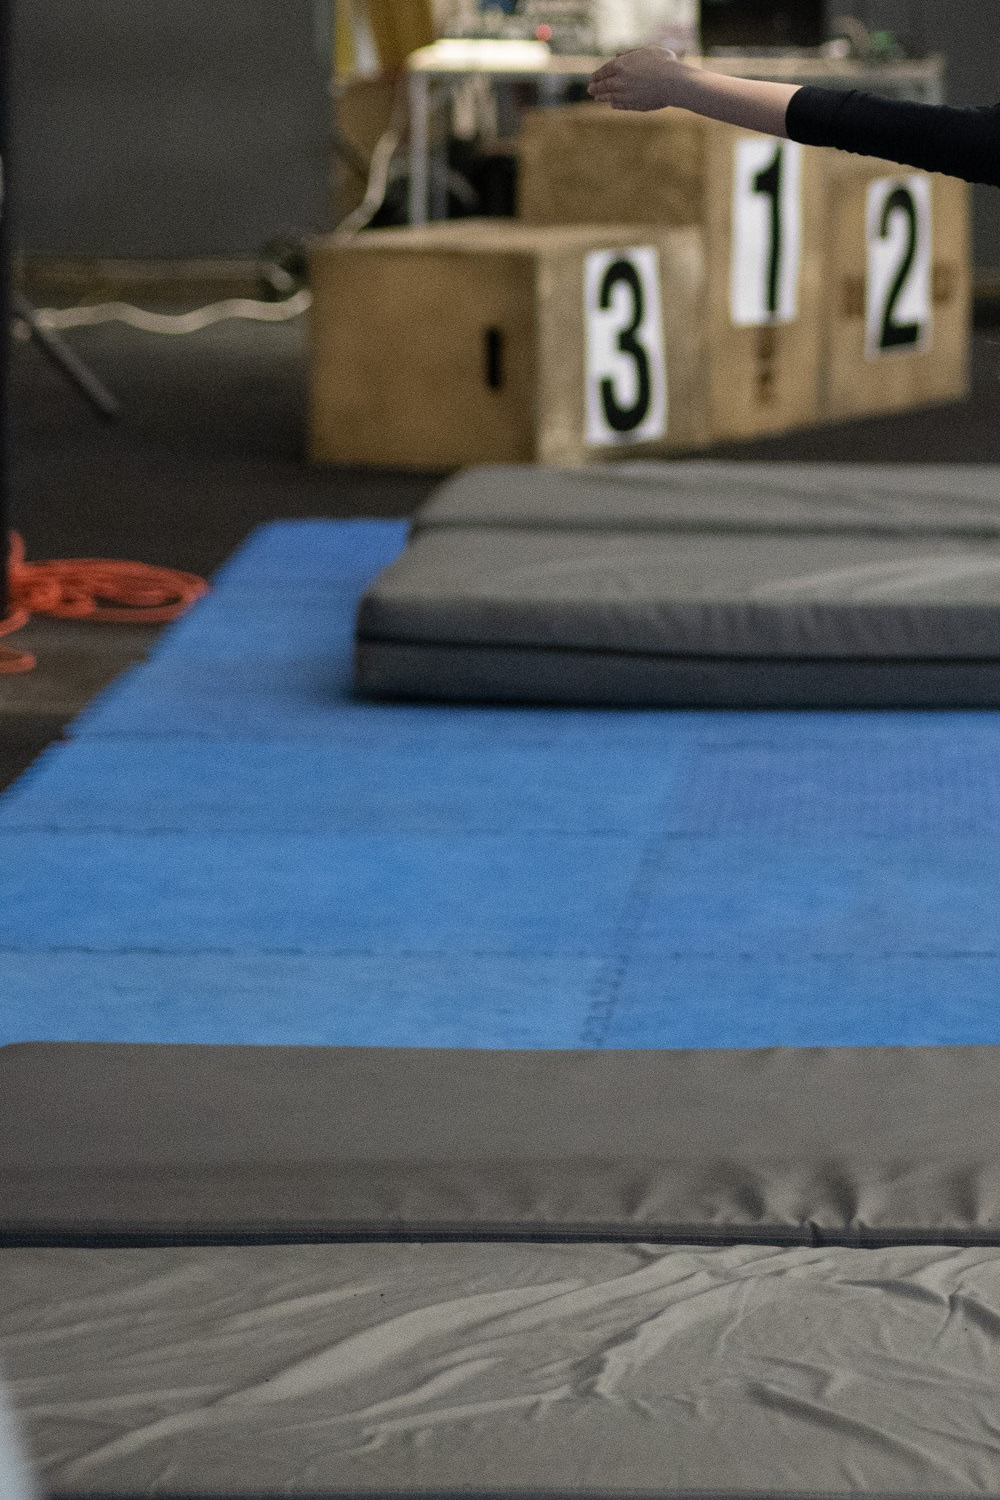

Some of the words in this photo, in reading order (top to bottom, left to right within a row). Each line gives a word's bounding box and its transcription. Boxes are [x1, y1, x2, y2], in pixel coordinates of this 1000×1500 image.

[752, 145, 784, 313] 1
[877, 185, 921, 351] 2
[599, 258, 652, 434] 3
